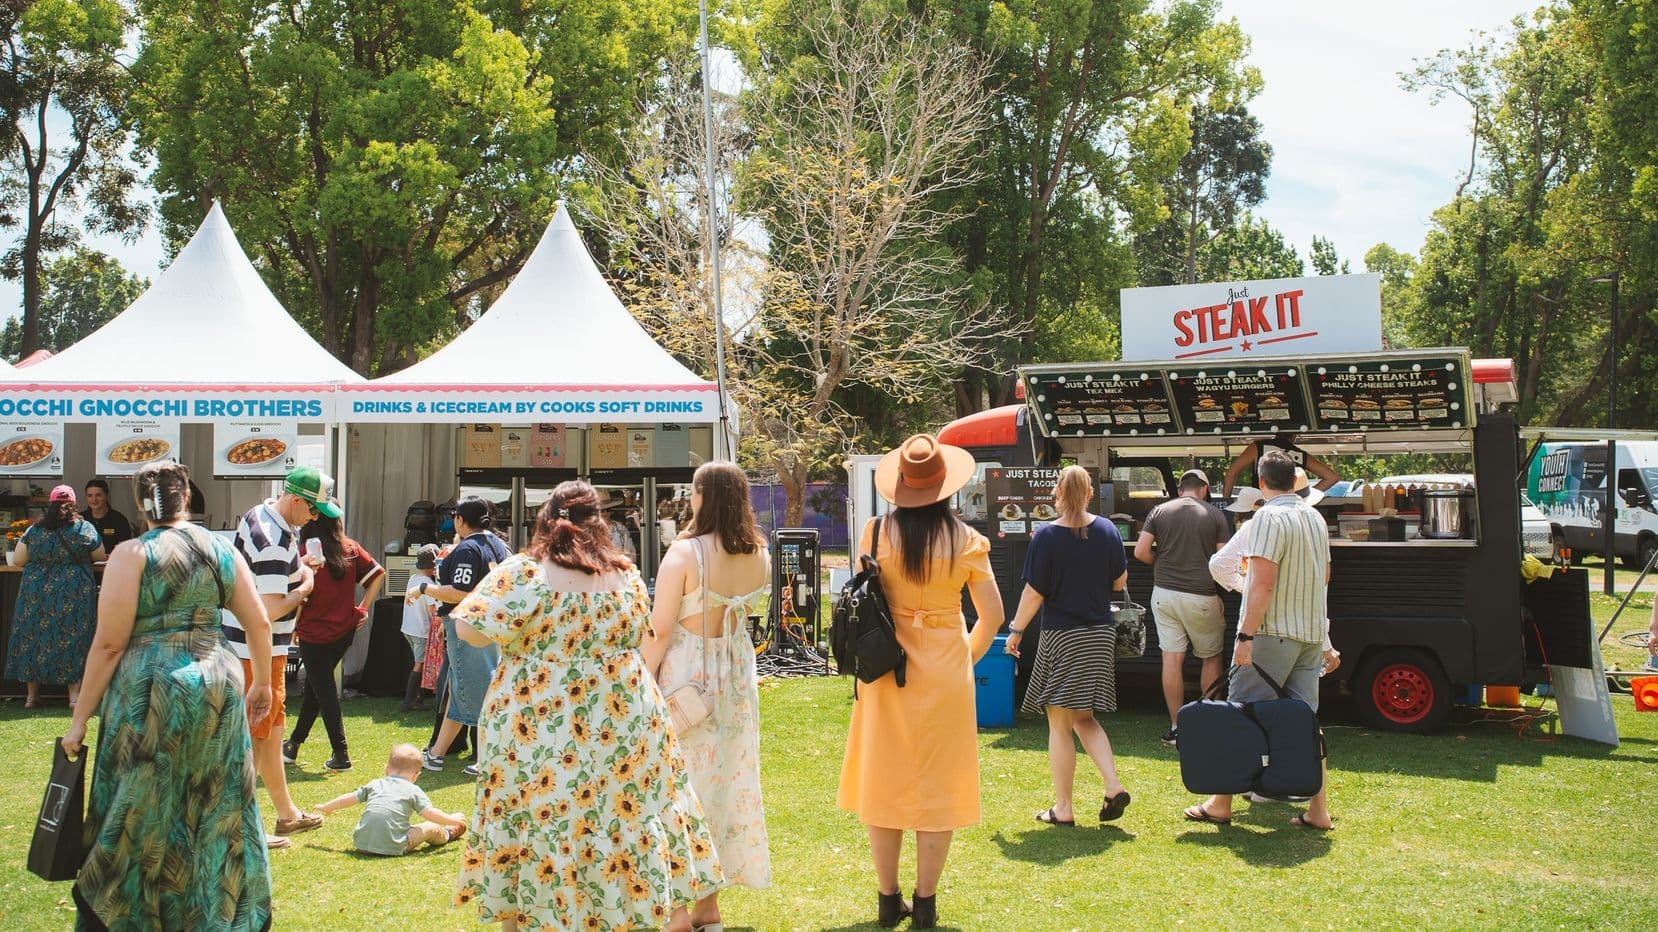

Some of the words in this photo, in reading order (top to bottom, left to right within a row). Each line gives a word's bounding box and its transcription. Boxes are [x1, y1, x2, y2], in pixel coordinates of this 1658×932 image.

[1227, 287, 1250, 306] Just
[1173, 296, 1272, 347] STEAK
[1275, 289, 1304, 330] IT
[1193, 377, 1221, 385] JUST
[1223, 376, 1261, 384] STEAK
[1334, 374, 1364, 382] JUST
[1367, 372, 1408, 381] STEAK
[1410, 372, 1422, 380] IT
[1357, 381, 1396, 389] CHEESE
[1397, 379, 1438, 388] STEAKS
[1195, 384, 1231, 392] WAGYU
[79, 399, 188, 416] GNOCCHI
[194, 399, 322, 416] BROTHERS
[353, 401, 412, 413] DRINKS
[416, 401, 426, 413] &
[430, 401, 512, 413] ICECREAM
[515, 401, 536, 413] BY
[540, 401, 595, 413] COOKS
[599, 401, 640, 413] SOFT
[644, 401, 703, 413] DRINKS
[1541, 452, 1566, 476] YOUTH
[1005, 469, 1030, 478] JUST
[1539, 475, 1566, 493] CONNECT
[454, 568, 472, 584] 26
